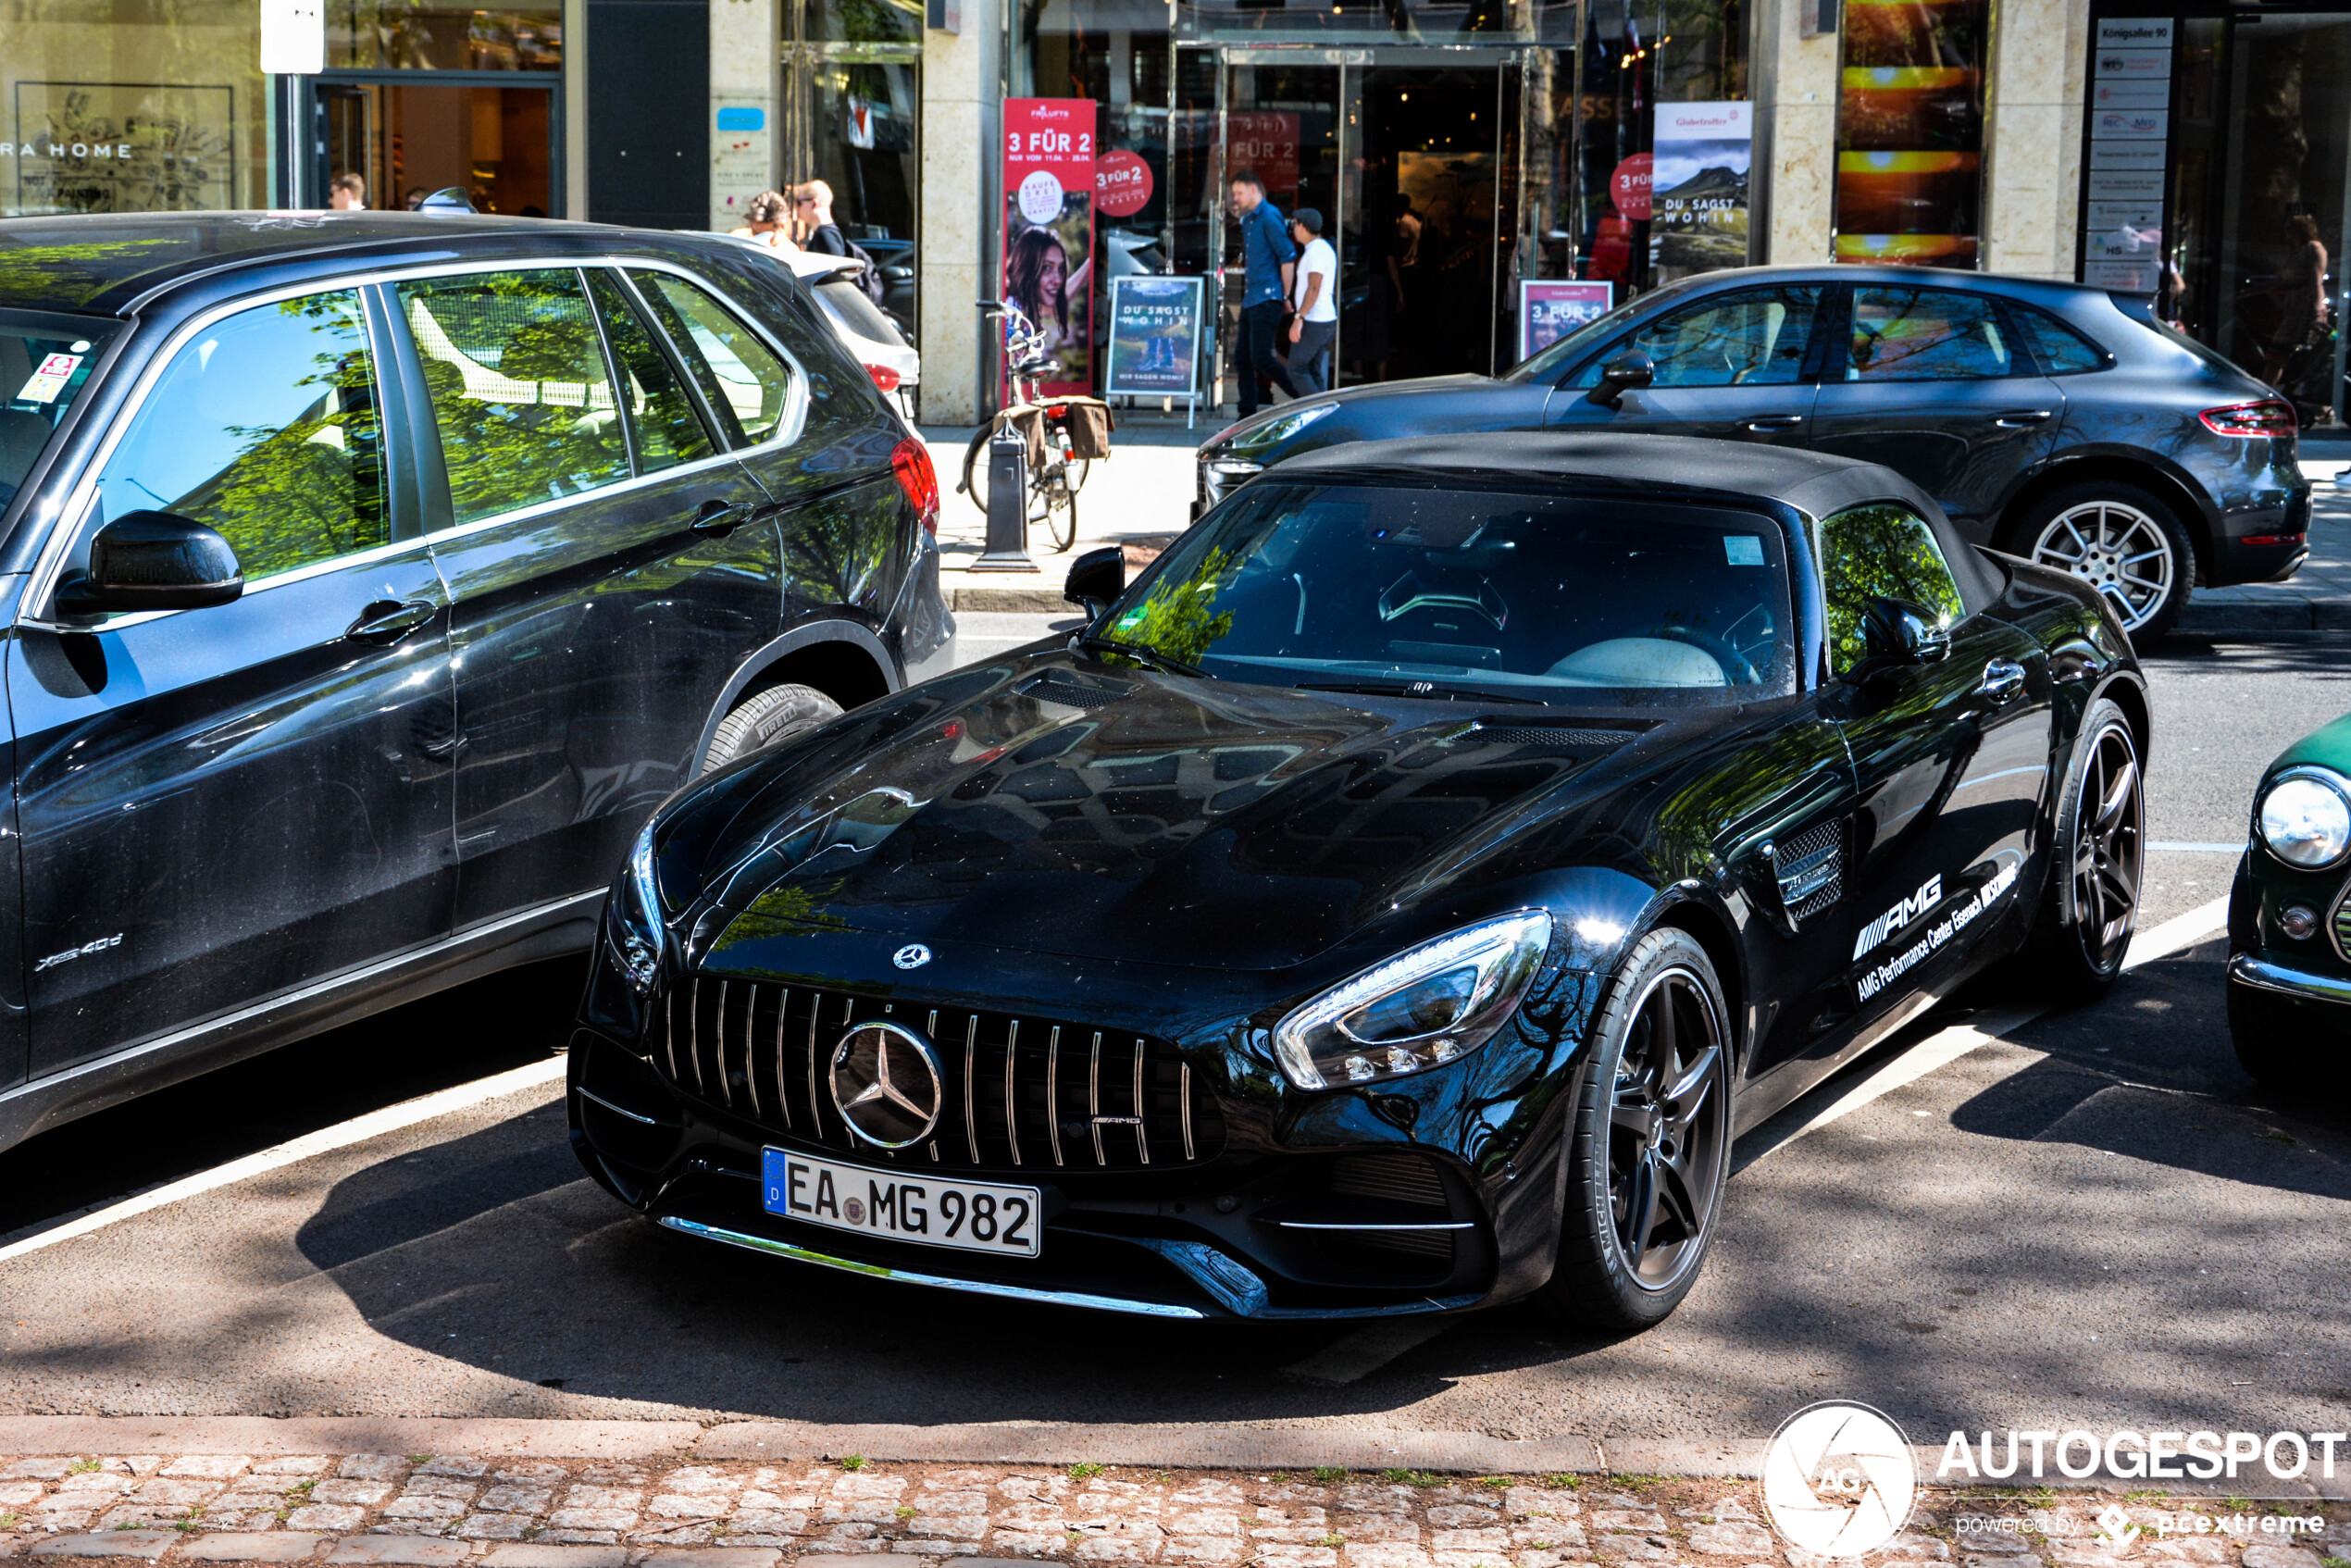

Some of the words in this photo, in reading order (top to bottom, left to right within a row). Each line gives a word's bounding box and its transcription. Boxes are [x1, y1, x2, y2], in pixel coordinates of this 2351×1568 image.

[2103, 27, 2154, 40] Königsallee
[2156, 27, 2168, 37] 90
[1676, 117, 1727, 127] Globetrotter
[1009, 132, 1021, 152] 3
[1029, 128, 1071, 152] FÜR
[1078, 132, 1090, 152] 2
[50, 143, 132, 159] HOME
[1235, 138, 1275, 158] FÜR
[1283, 142, 1294, 158] 2
[1096, 173, 1107, 187] 3
[1108, 169, 1130, 183] FÜR
[1131, 167, 1143, 180] 2
[1621, 175, 1631, 189] 3
[1666, 199, 1685, 209] DU
[1692, 199, 1735, 209] SAGST
[1665, 212, 1735, 223] WOHIN
[1123, 305, 1141, 315] DU
[1148, 305, 1189, 315] SAGST
[1532, 305, 1542, 318] 3
[1550, 303, 1585, 318] FÜR
[1590, 306, 1601, 319] 2
[1122, 317, 1188, 326] WOHIN
[1873, 873, 1942, 950] AMG
[1858, 971, 1882, 1002] AMG
[1877, 940, 1930, 987] Performance
[1927, 920, 1954, 952] Center
[1951, 894, 1984, 931] Eisenach
[770, 1187, 780, 1202] D
[788, 1163, 840, 1219] EA
[869, 1179, 928, 1236] MG
[939, 1190, 1031, 1247] 982
